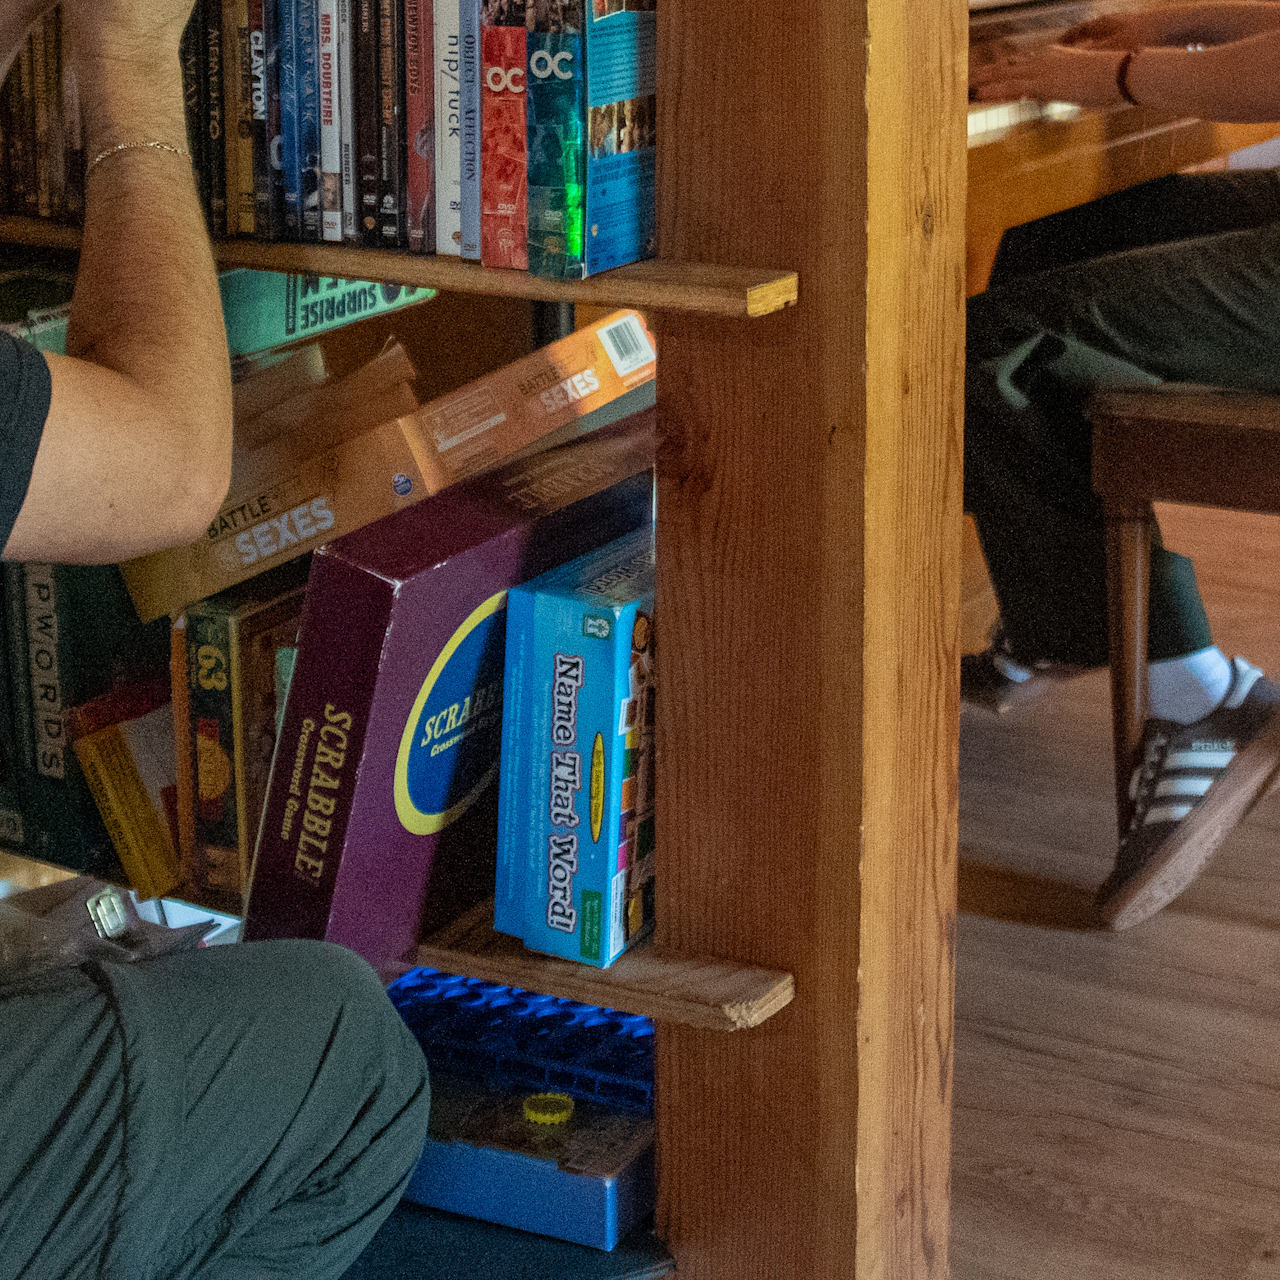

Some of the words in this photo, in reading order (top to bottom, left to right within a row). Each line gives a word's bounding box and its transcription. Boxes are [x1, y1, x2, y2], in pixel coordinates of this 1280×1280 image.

[321, 13, 332, 47] MRS.
[464, 33, 477, 84] OBJECT
[249, 29, 267, 121] CLAYTON
[321, 52, 333, 126] DOUBTFIRE
[408, 59, 420, 94] BOYS
[486, 66, 525, 94] OC
[529, 49, 575, 81] OC
[300, 283, 378, 330] SURPRISE
[540, 368, 600, 414] SEXES
[207, 496, 271, 539] BATTLE
[235, 497, 335, 565] SEXES
[30, 580, 62, 777] PWORDS
[553, 653, 584, 746] Name
[288, 718, 316, 797] Crossword
[280, 797, 300, 841] Game
[294, 702, 353, 880] SCRABBLE
[551, 752, 582, 830] That
[548, 835, 579, 934] Word!
